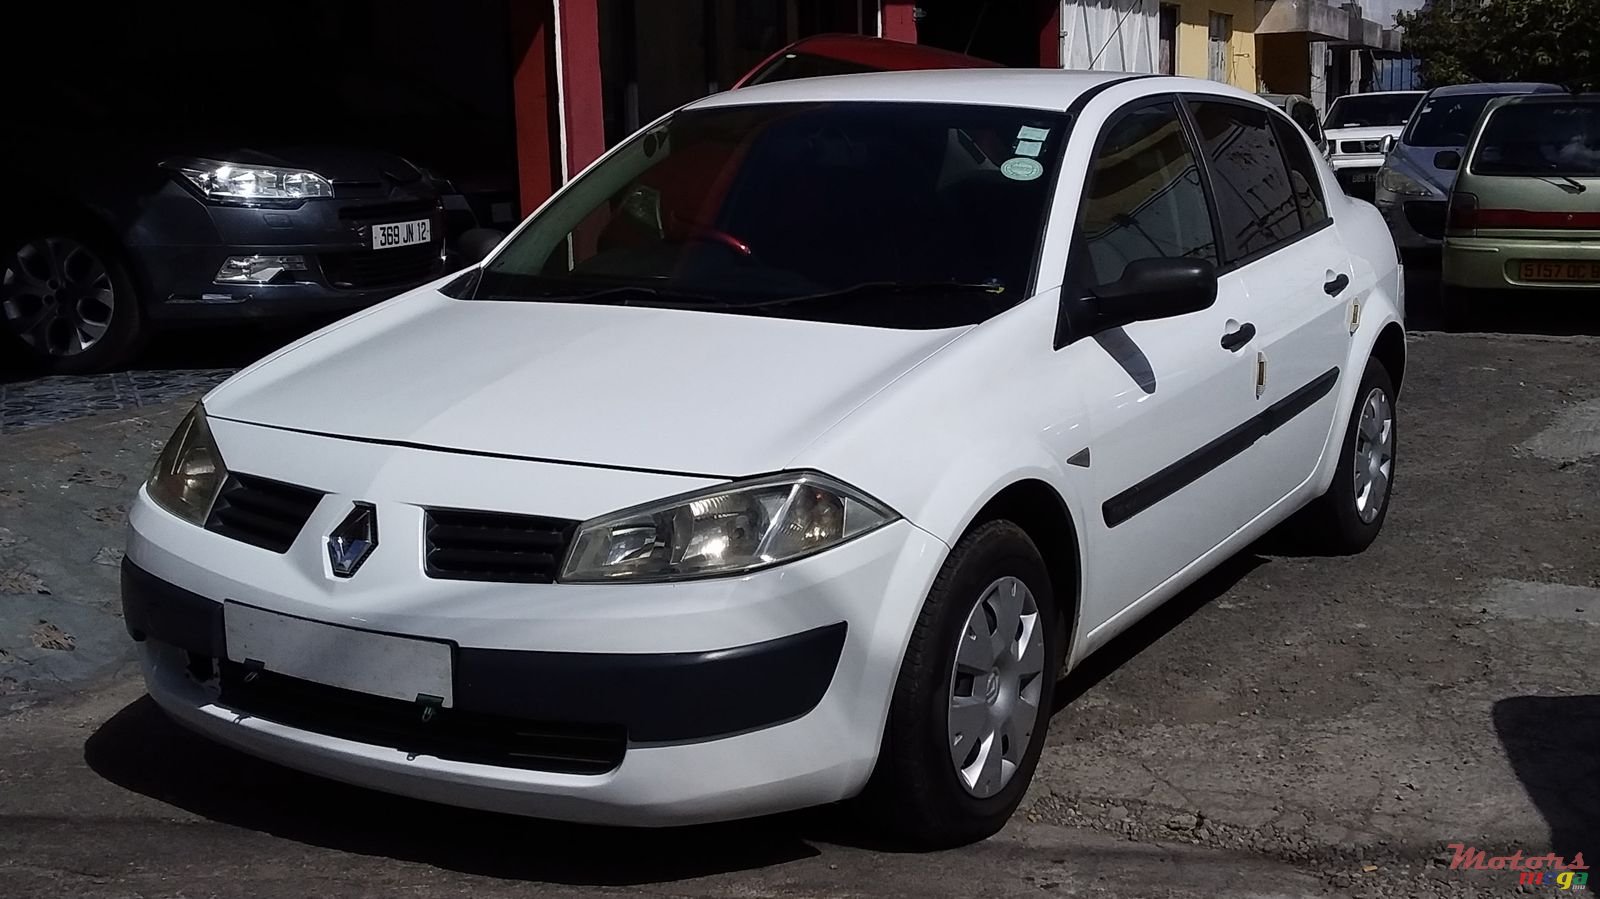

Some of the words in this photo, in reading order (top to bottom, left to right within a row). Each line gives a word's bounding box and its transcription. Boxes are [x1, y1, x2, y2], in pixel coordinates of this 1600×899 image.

[380, 225, 400, 246] 369
[402, 223, 414, 243] JN
[417, 221, 427, 241] 12
[1524, 263, 1562, 278] 5157
